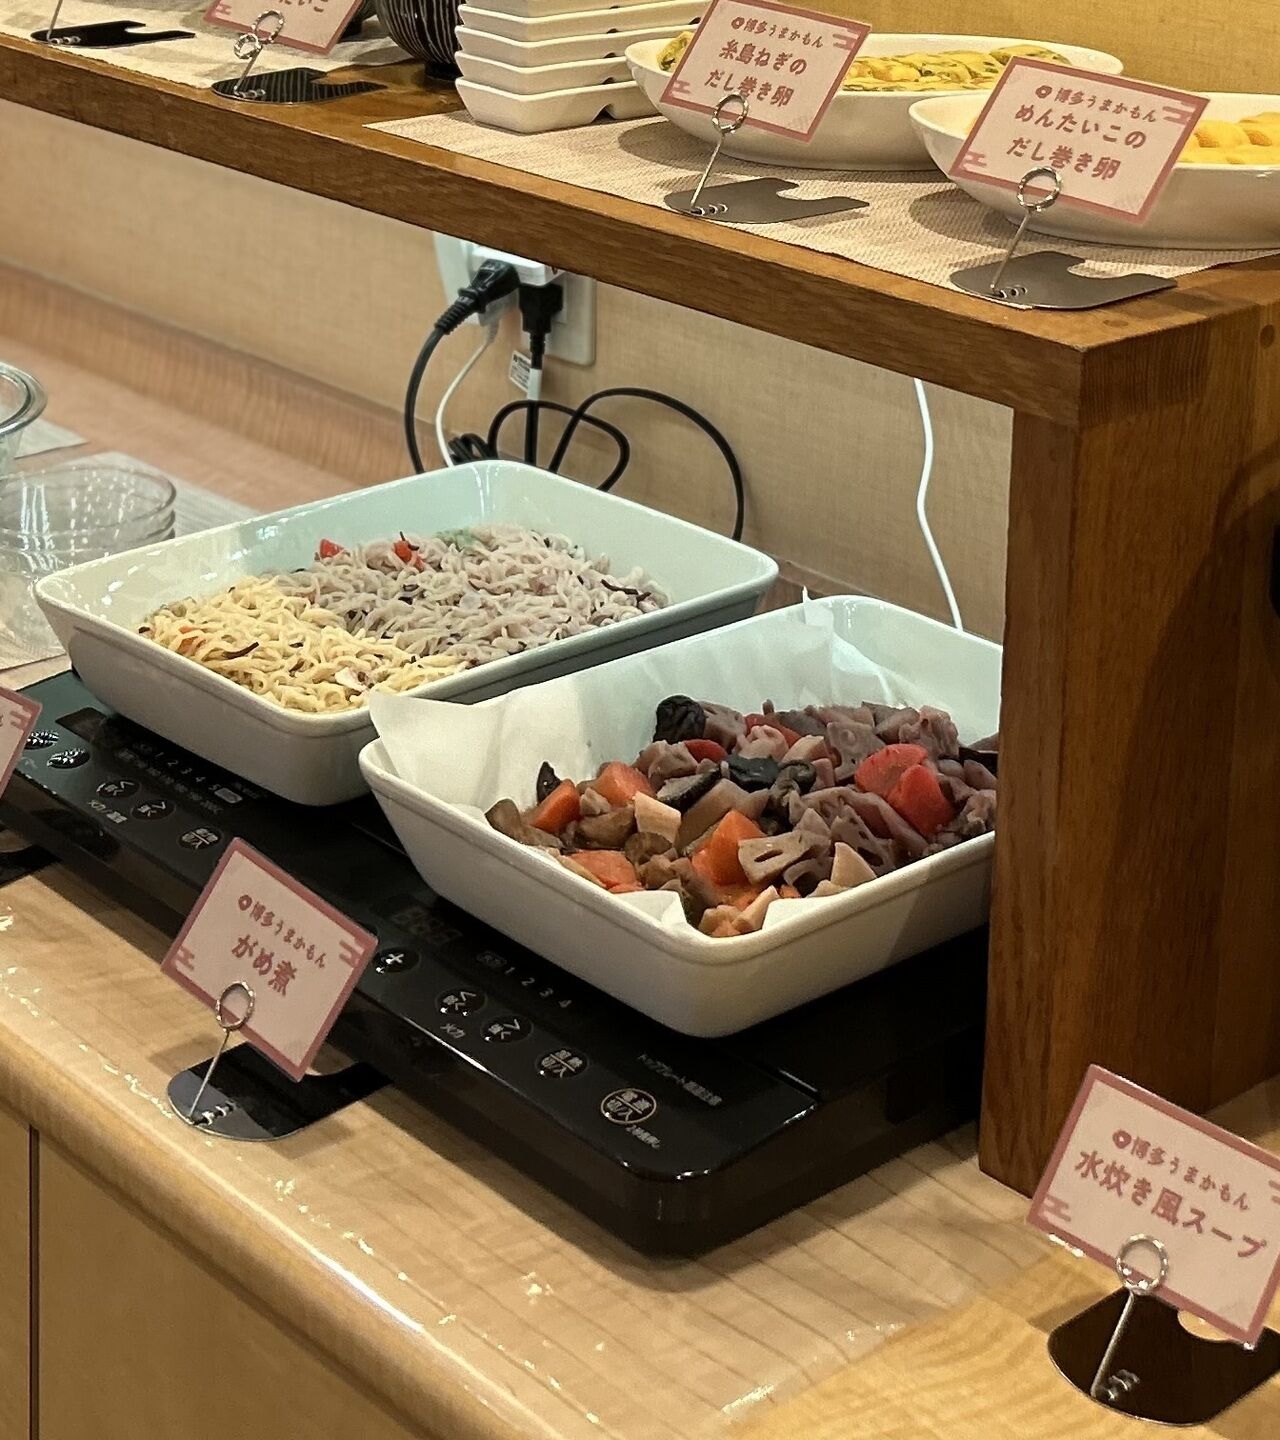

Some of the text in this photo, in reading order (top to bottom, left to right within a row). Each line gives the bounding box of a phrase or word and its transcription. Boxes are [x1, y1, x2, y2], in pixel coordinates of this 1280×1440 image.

[744, 18, 824, 49] 博多うまかもん
[718, 38, 808, 76] 糸島ねぎの
[704, 68, 795, 108] だし巻き卵
[1054, 87, 1157, 123] 博多うまかもん
[1014, 104, 1147, 149] めんたいこの
[1006, 136, 1122, 181] だし巻き卵
[249, 901, 327, 969] 博多うまかもん
[231, 934, 298, 997] がめ煮
[1130, 1136, 1250, 1211] 博多うまかもん
[1074, 1150, 1268, 1258] 水炊き風スープ
